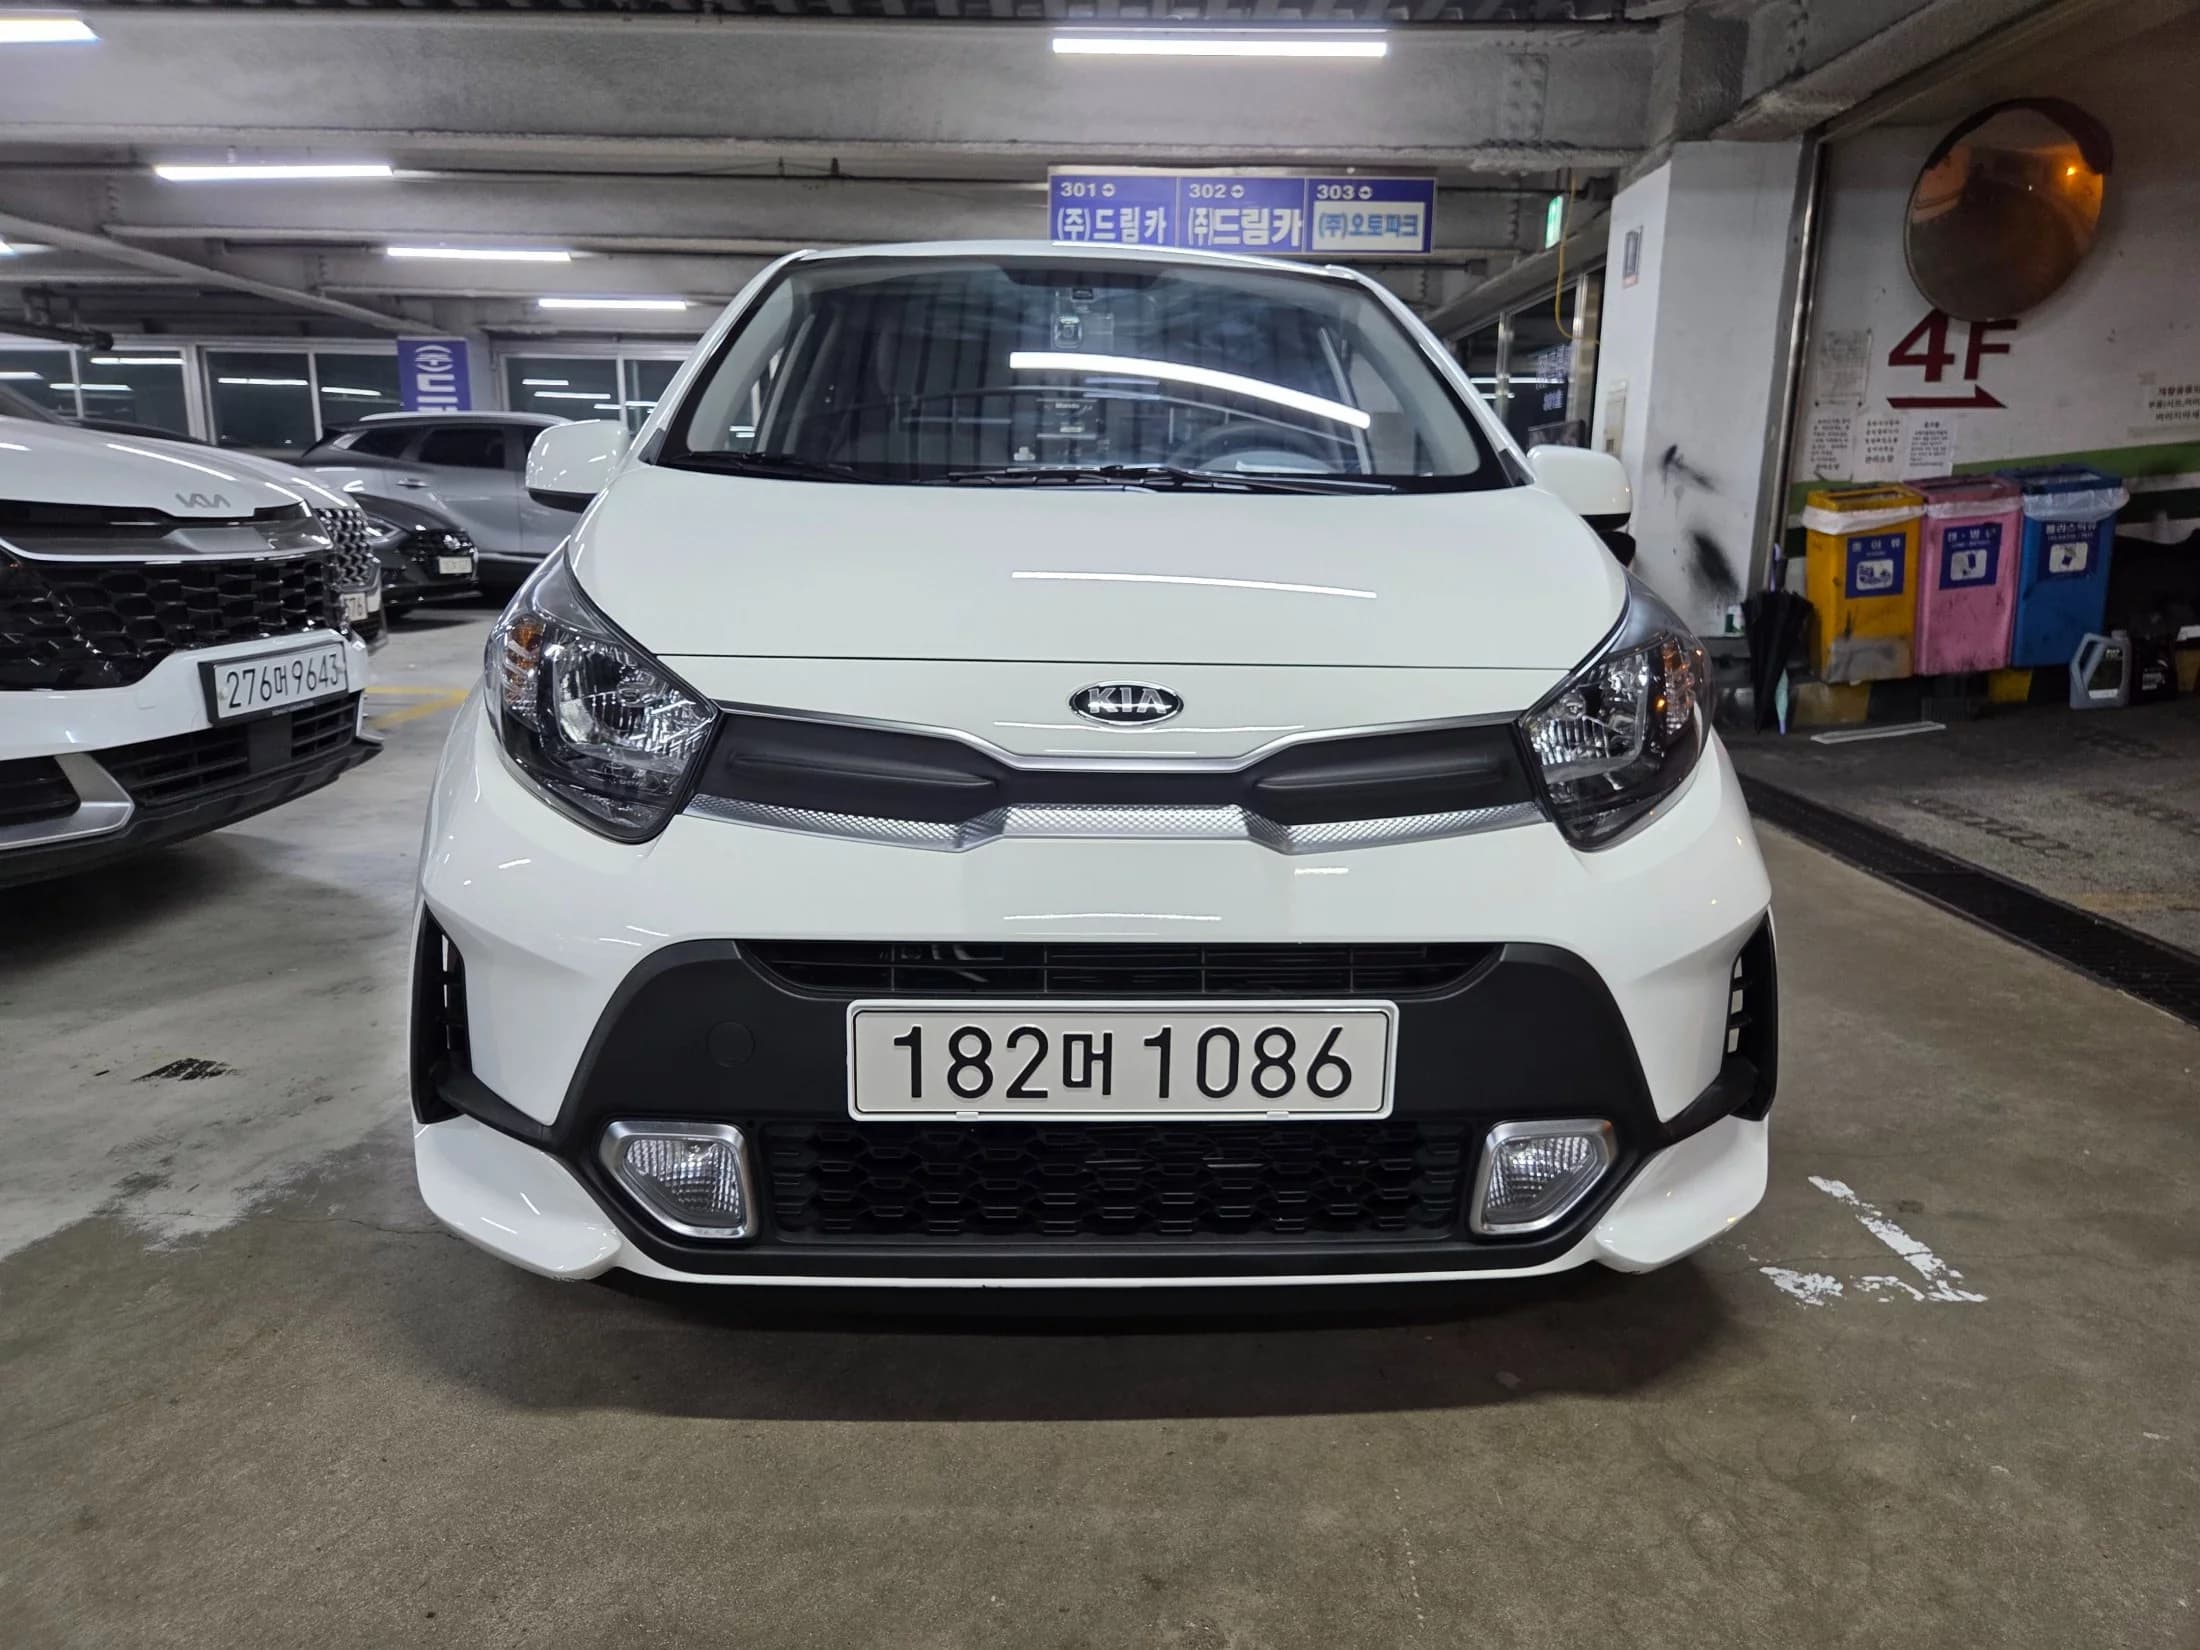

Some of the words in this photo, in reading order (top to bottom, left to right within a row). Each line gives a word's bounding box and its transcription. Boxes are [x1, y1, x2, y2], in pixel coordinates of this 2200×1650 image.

[1060, 182, 1096, 197] 301
[1189, 184, 1227, 199] 302
[1316, 184, 1355, 200] 303
[1057, 207, 1167, 244] (주)드림카
[1187, 207, 1304, 247] (주)드림카
[1318, 212, 1419, 240] (주)오토파크
[1888, 308, 2019, 382] 4F
[1088, 687, 1168, 714] KIA
